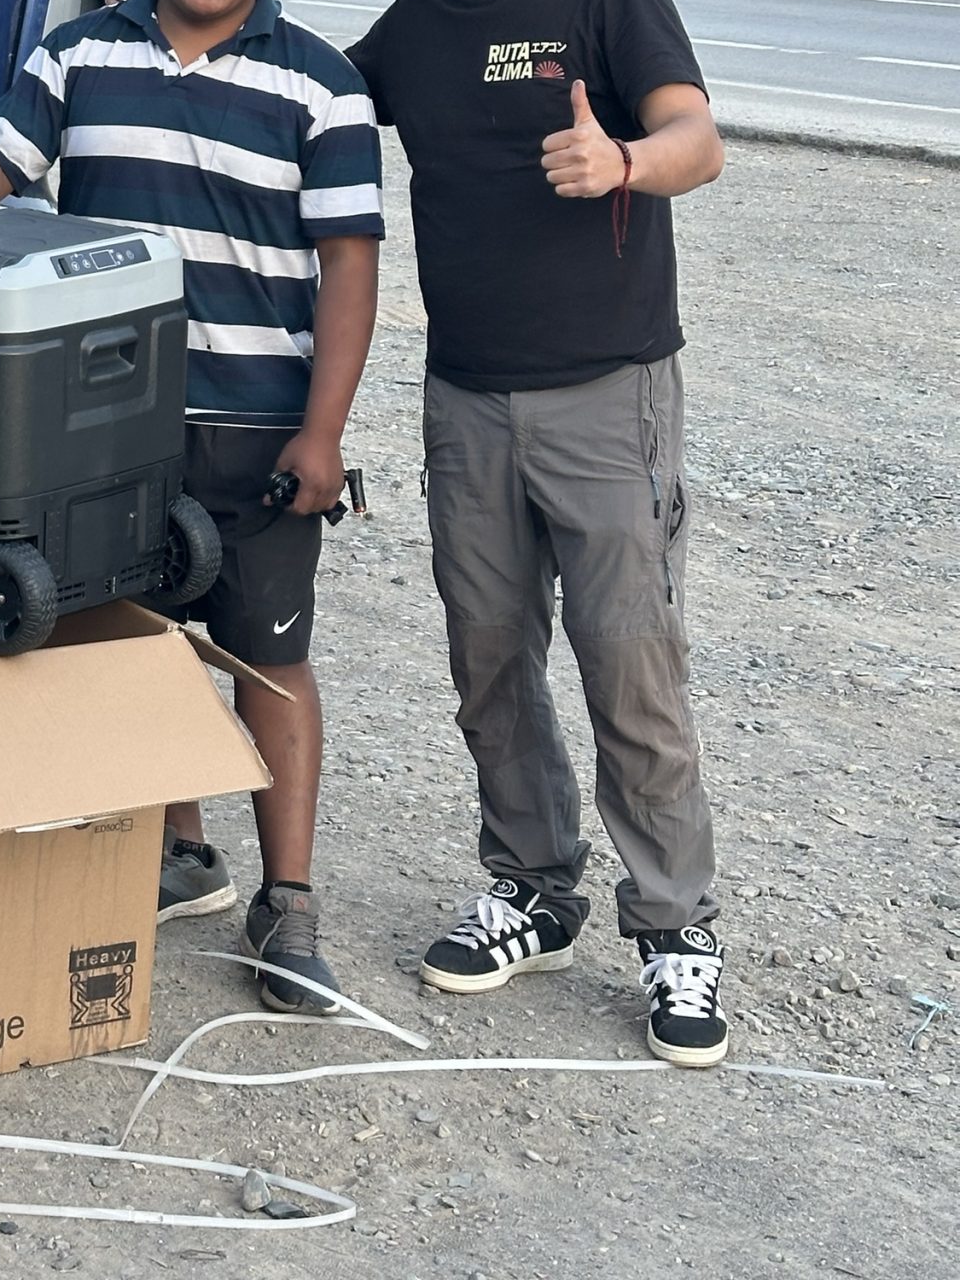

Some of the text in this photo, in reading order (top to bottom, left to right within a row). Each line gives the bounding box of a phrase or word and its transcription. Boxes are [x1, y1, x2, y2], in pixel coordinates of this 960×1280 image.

[487, 41, 530, 63] RUTA
[530, 41, 567, 54] エアコン
[483, 61, 533, 82] CLIMA
[75, 948, 132, 968] Heavy
